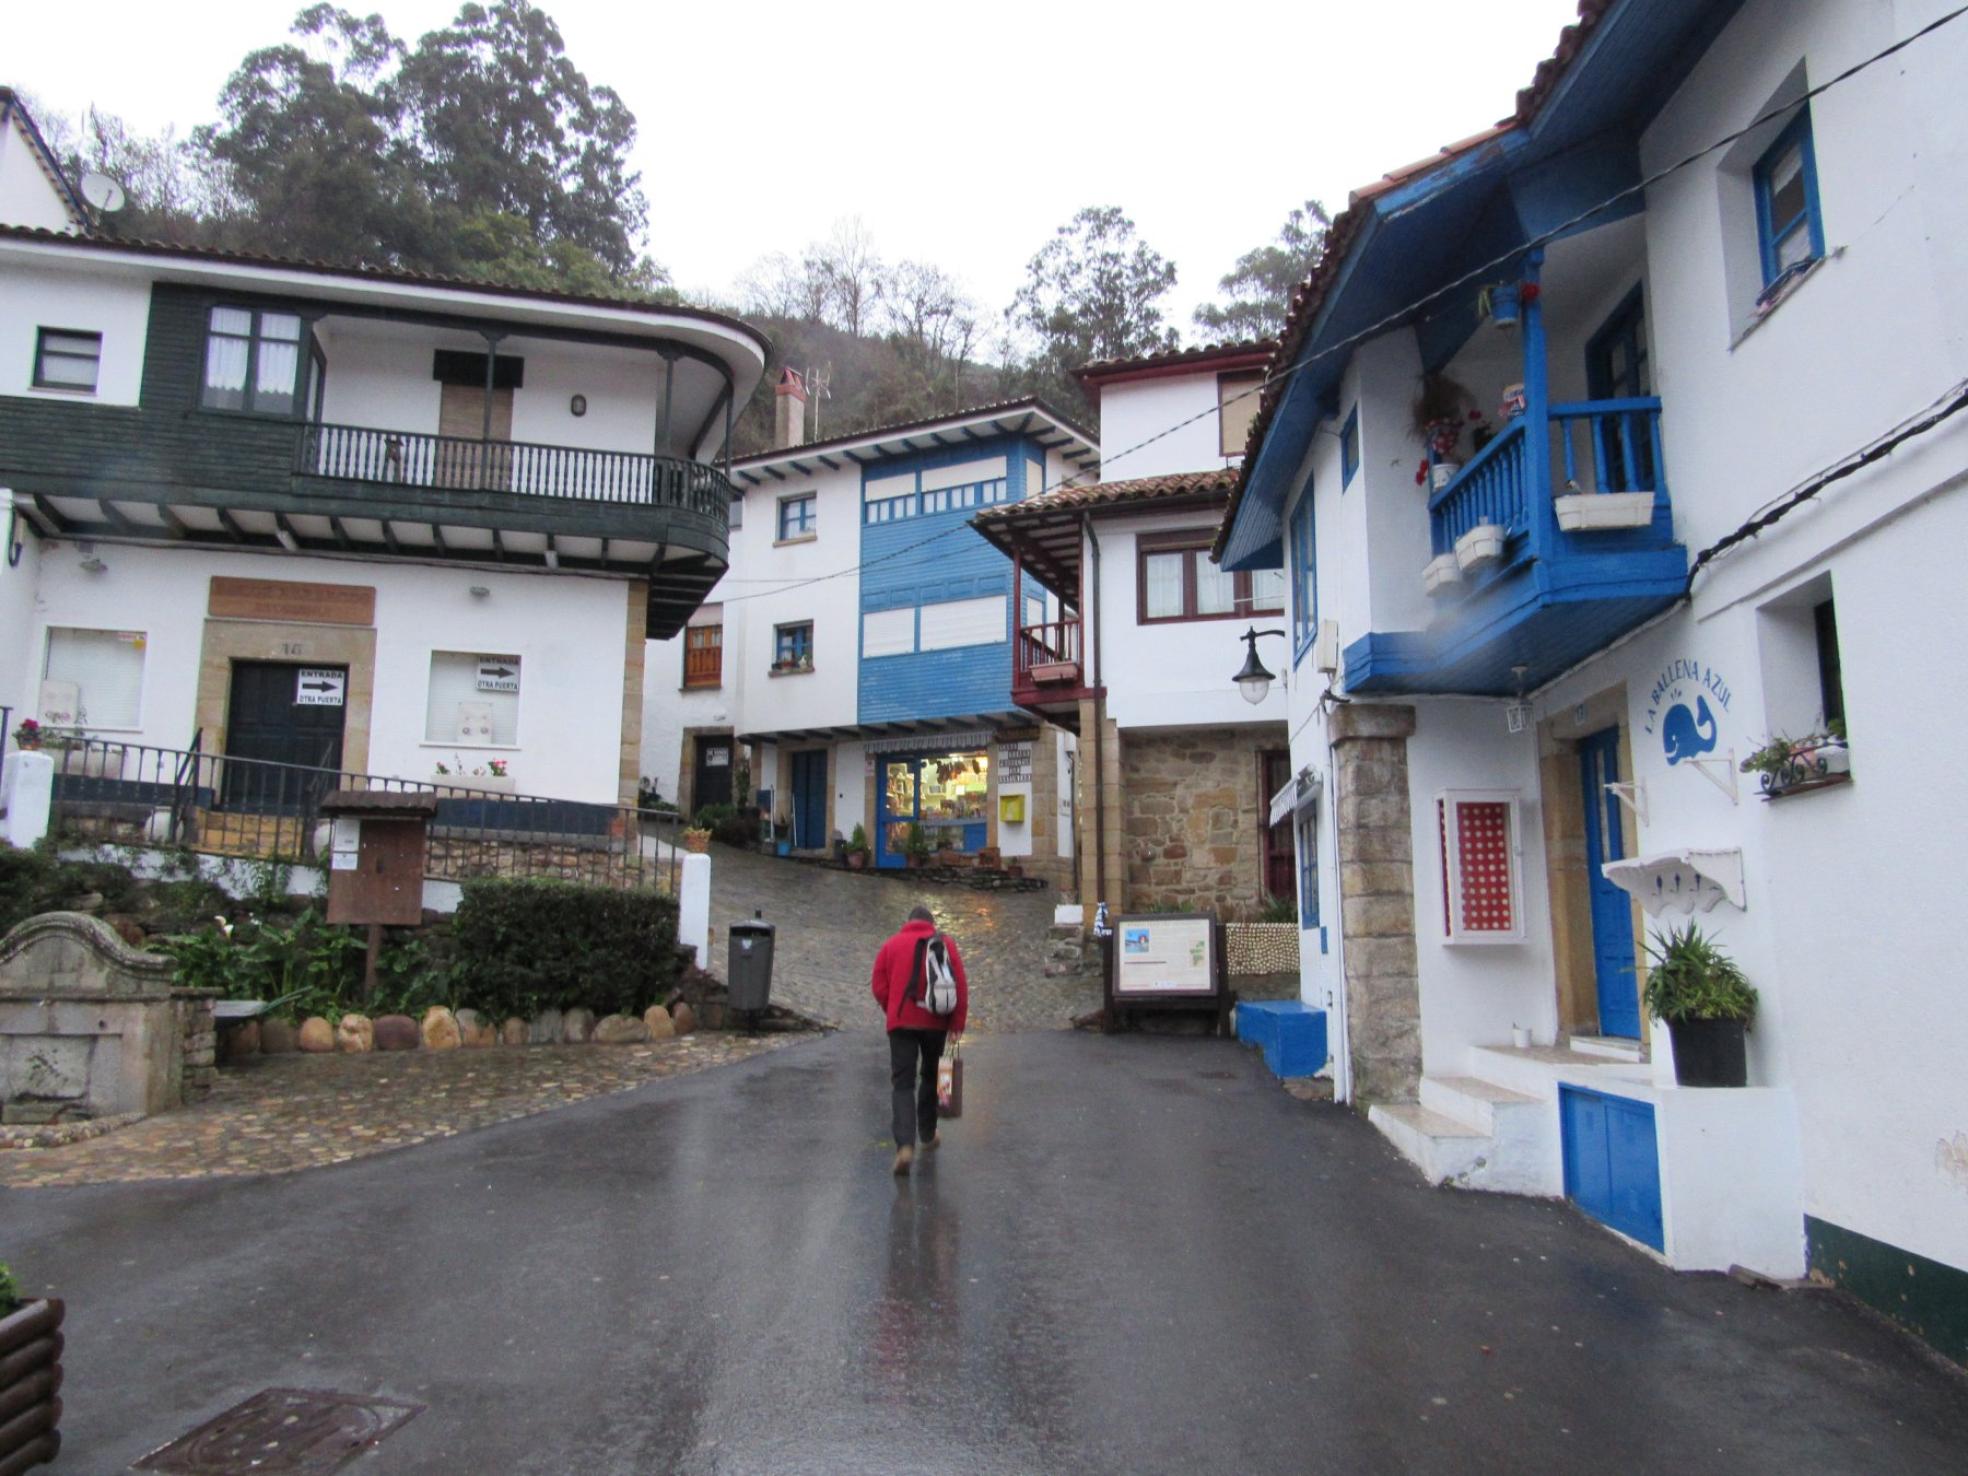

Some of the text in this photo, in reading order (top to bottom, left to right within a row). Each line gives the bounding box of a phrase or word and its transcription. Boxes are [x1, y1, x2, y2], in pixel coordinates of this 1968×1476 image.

[480, 656, 519, 666] ENTRADA
[301, 671, 343, 679] ENTRADA
[478, 680, 518, 690] OTRA PUERTA
[318, 696, 342, 704] PUERTA
[1645, 659, 1731, 734] LA BALLENA AZUL
